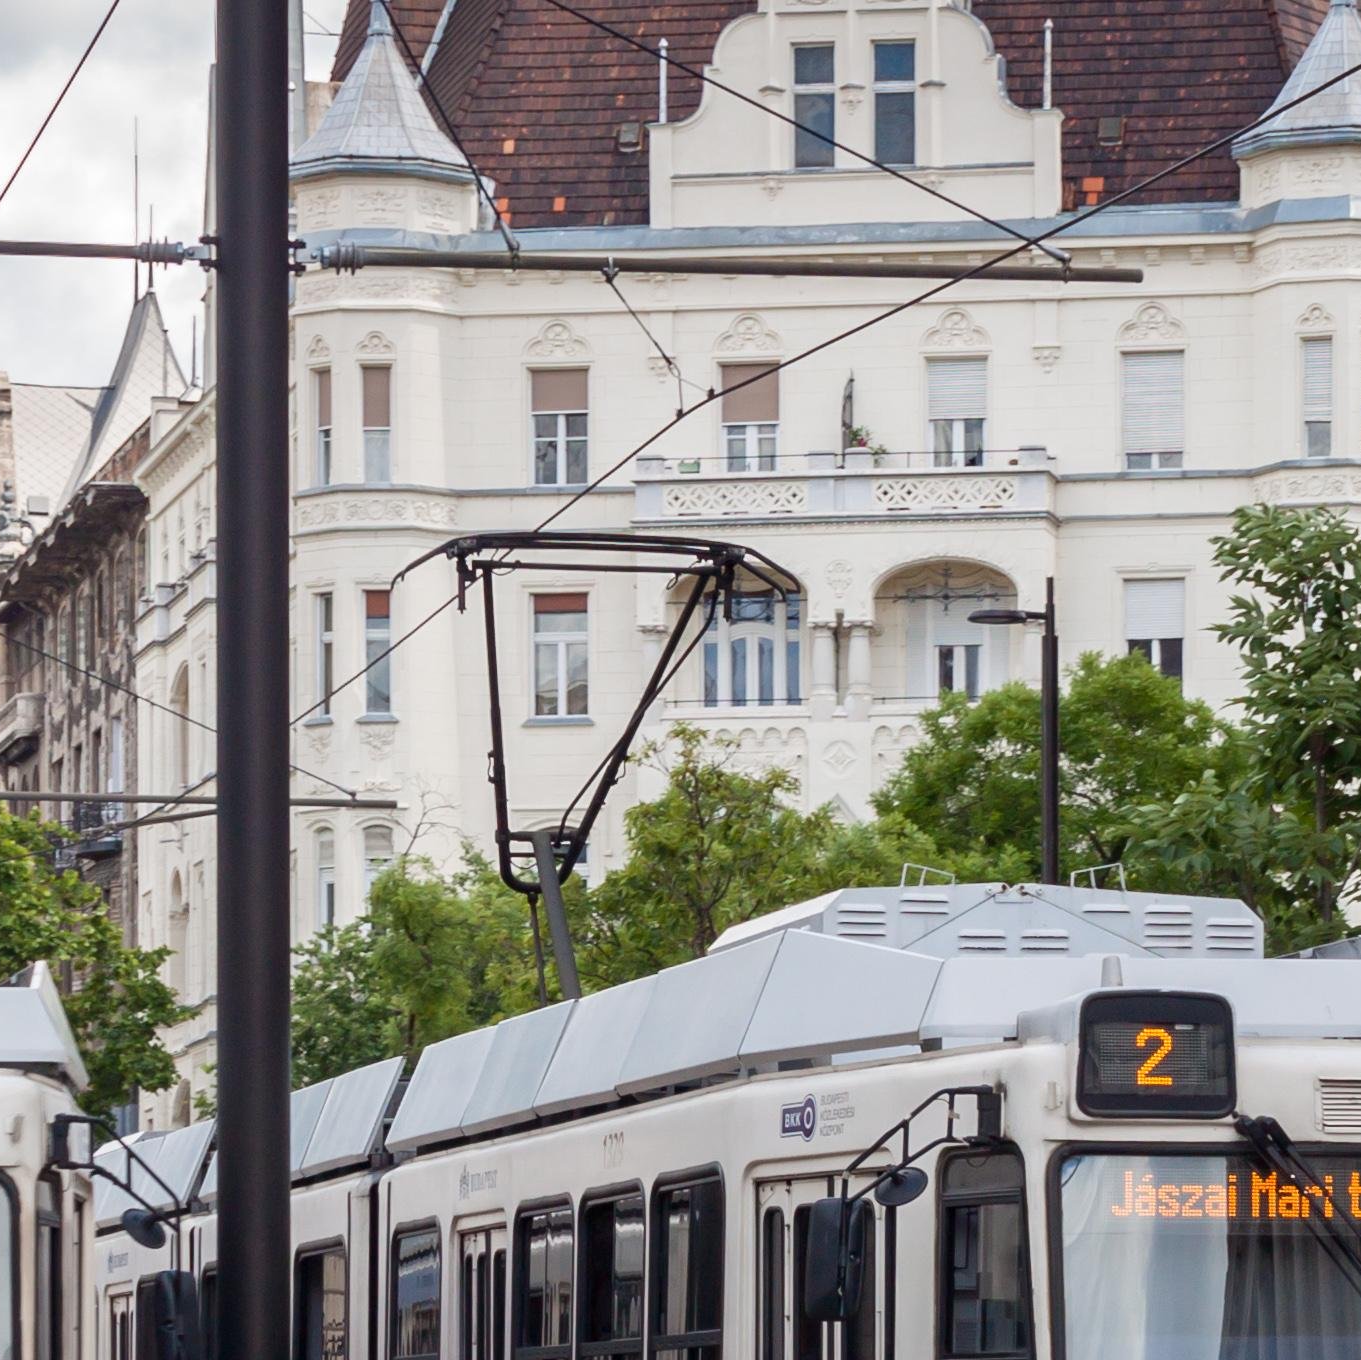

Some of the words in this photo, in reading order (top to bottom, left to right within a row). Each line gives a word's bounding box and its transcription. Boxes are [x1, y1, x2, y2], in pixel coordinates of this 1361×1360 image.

[1136, 1027, 1173, 1086] 2
[784, 1112, 801, 1128] BKK
[1111, 1170, 1238, 1218] Jászai
[1250, 1170, 1334, 1218] Mari
